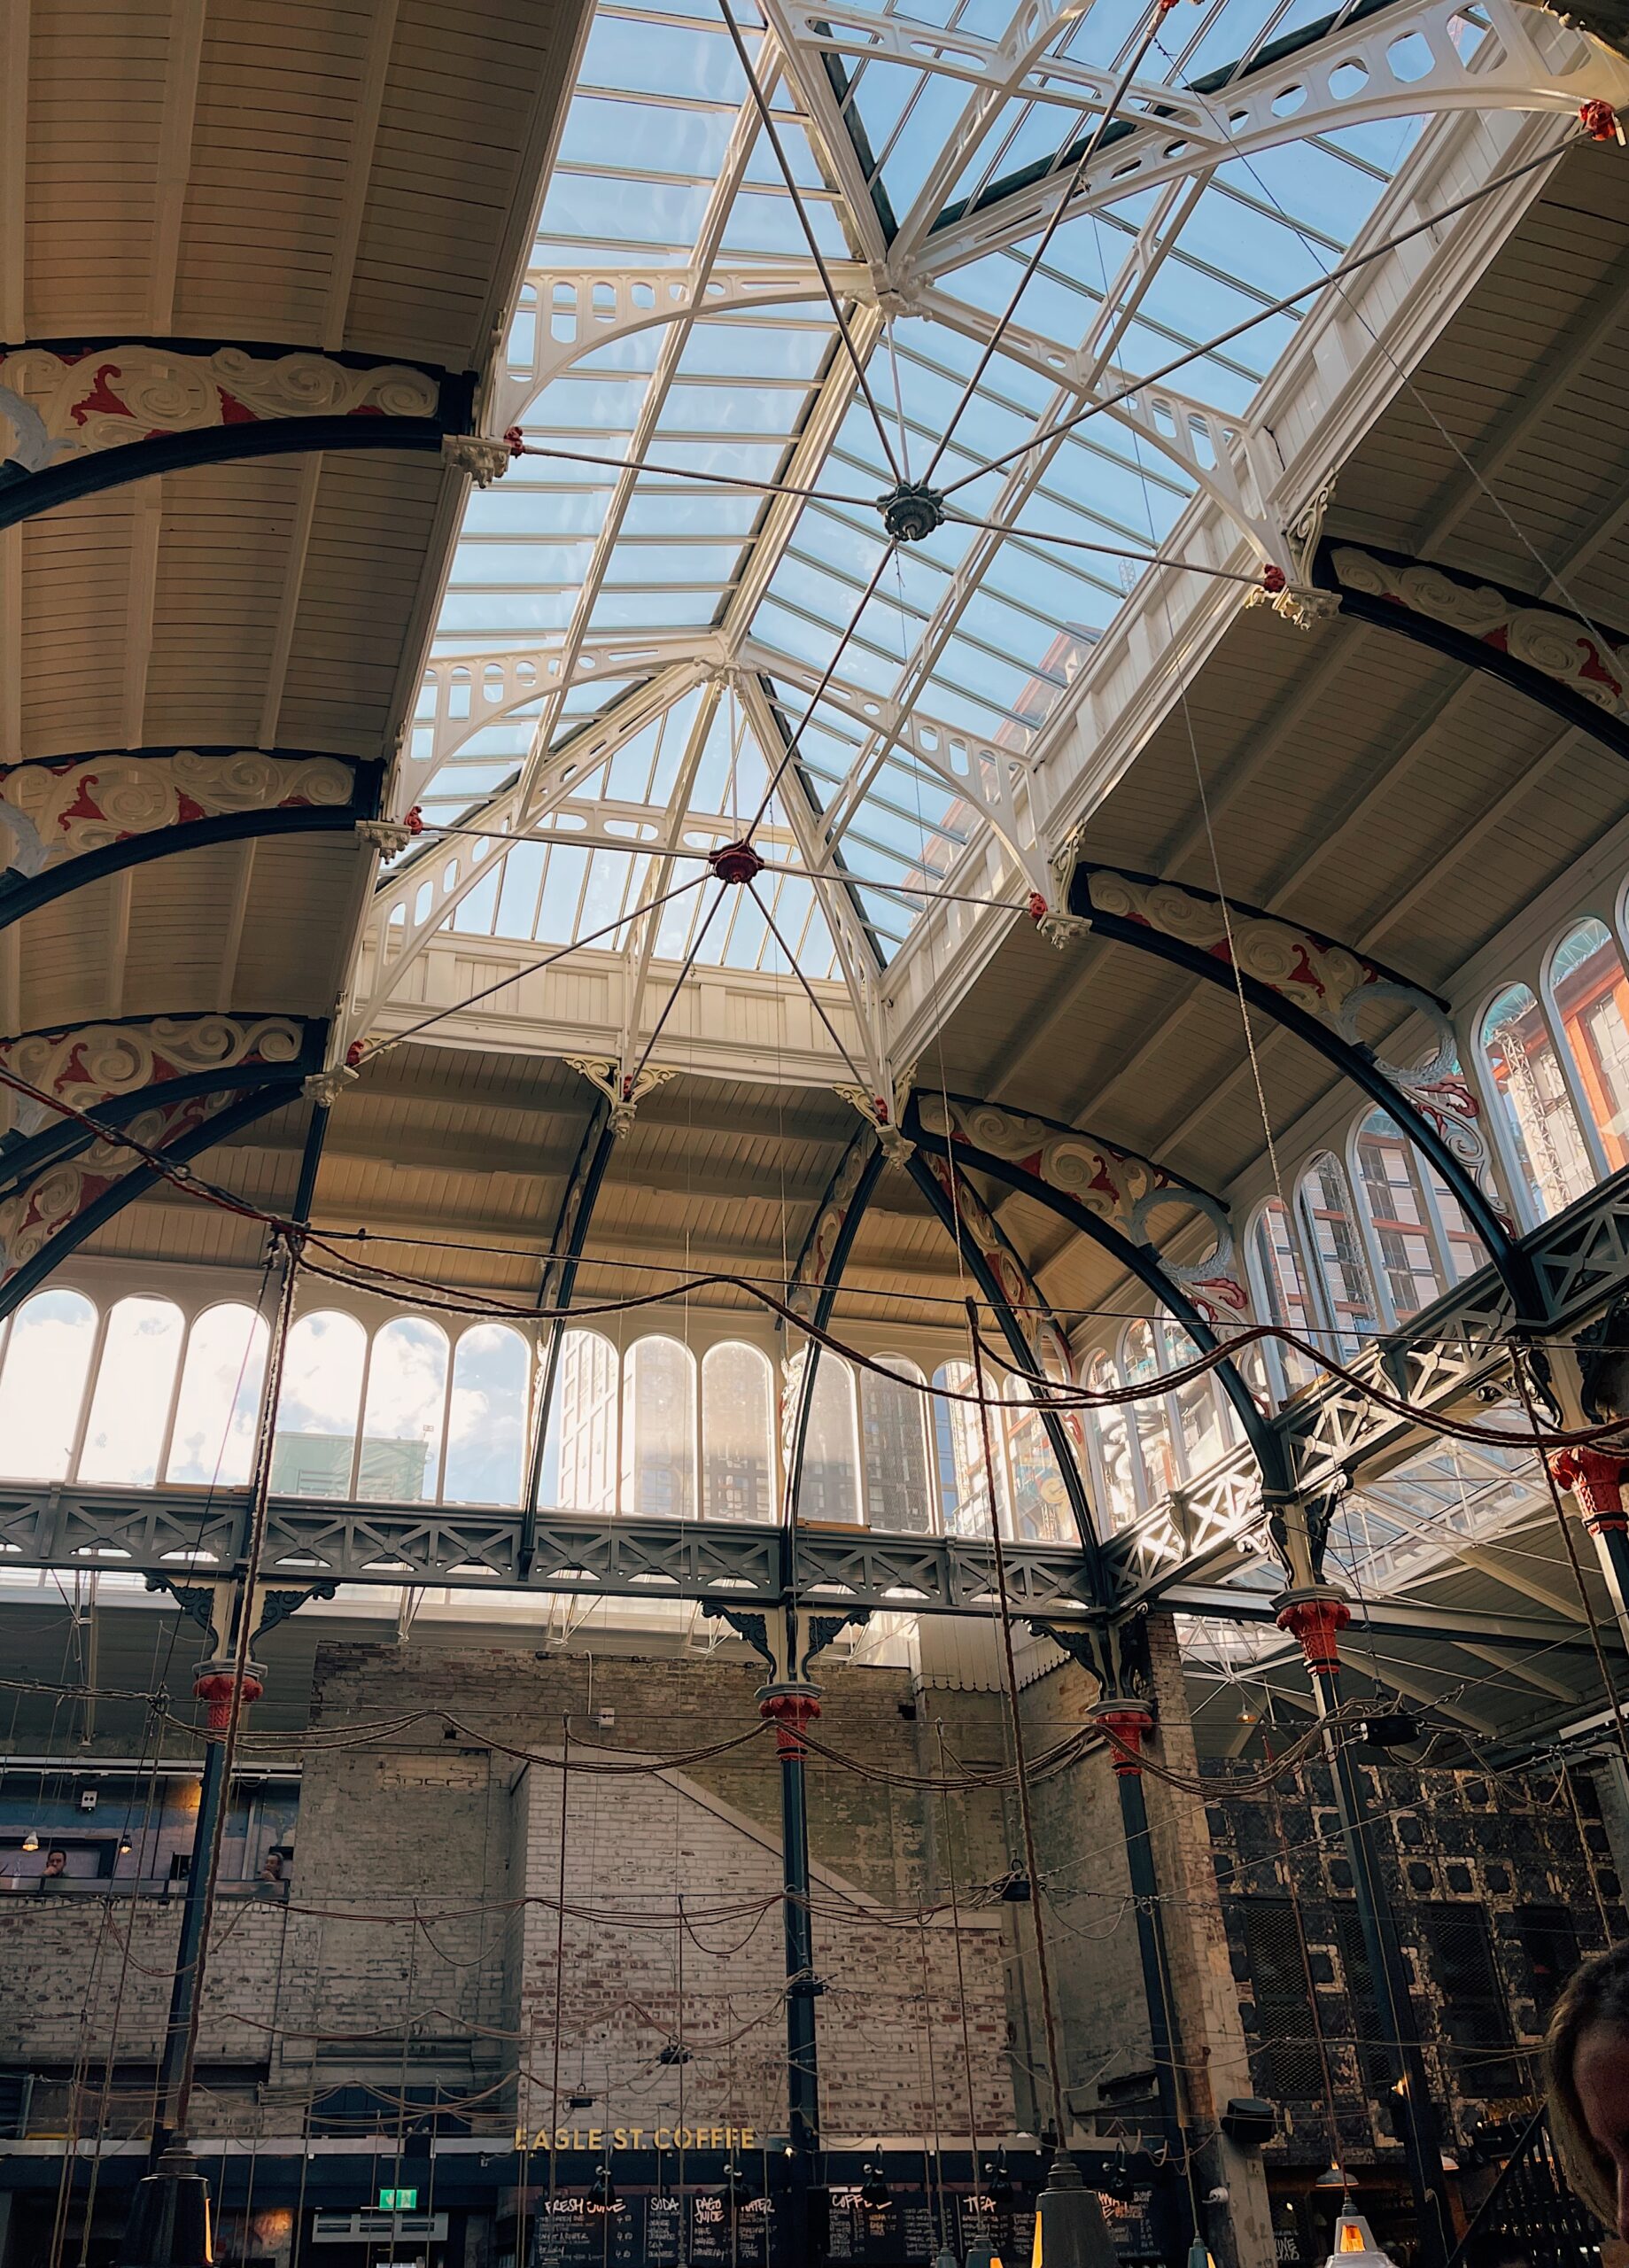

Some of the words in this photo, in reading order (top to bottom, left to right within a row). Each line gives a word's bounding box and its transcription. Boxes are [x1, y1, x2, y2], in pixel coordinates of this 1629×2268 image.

[514, 2128, 602, 2150] EAGLE
[613, 2127, 648, 2150] ST.
[654, 2126, 755, 2150] COFFEE
[544, 2197, 584, 2214] FRESH
[650, 2196, 679, 2210] SODA
[963, 2195, 997, 2213] TEA
[694, 2210, 725, 2224] JUICE
